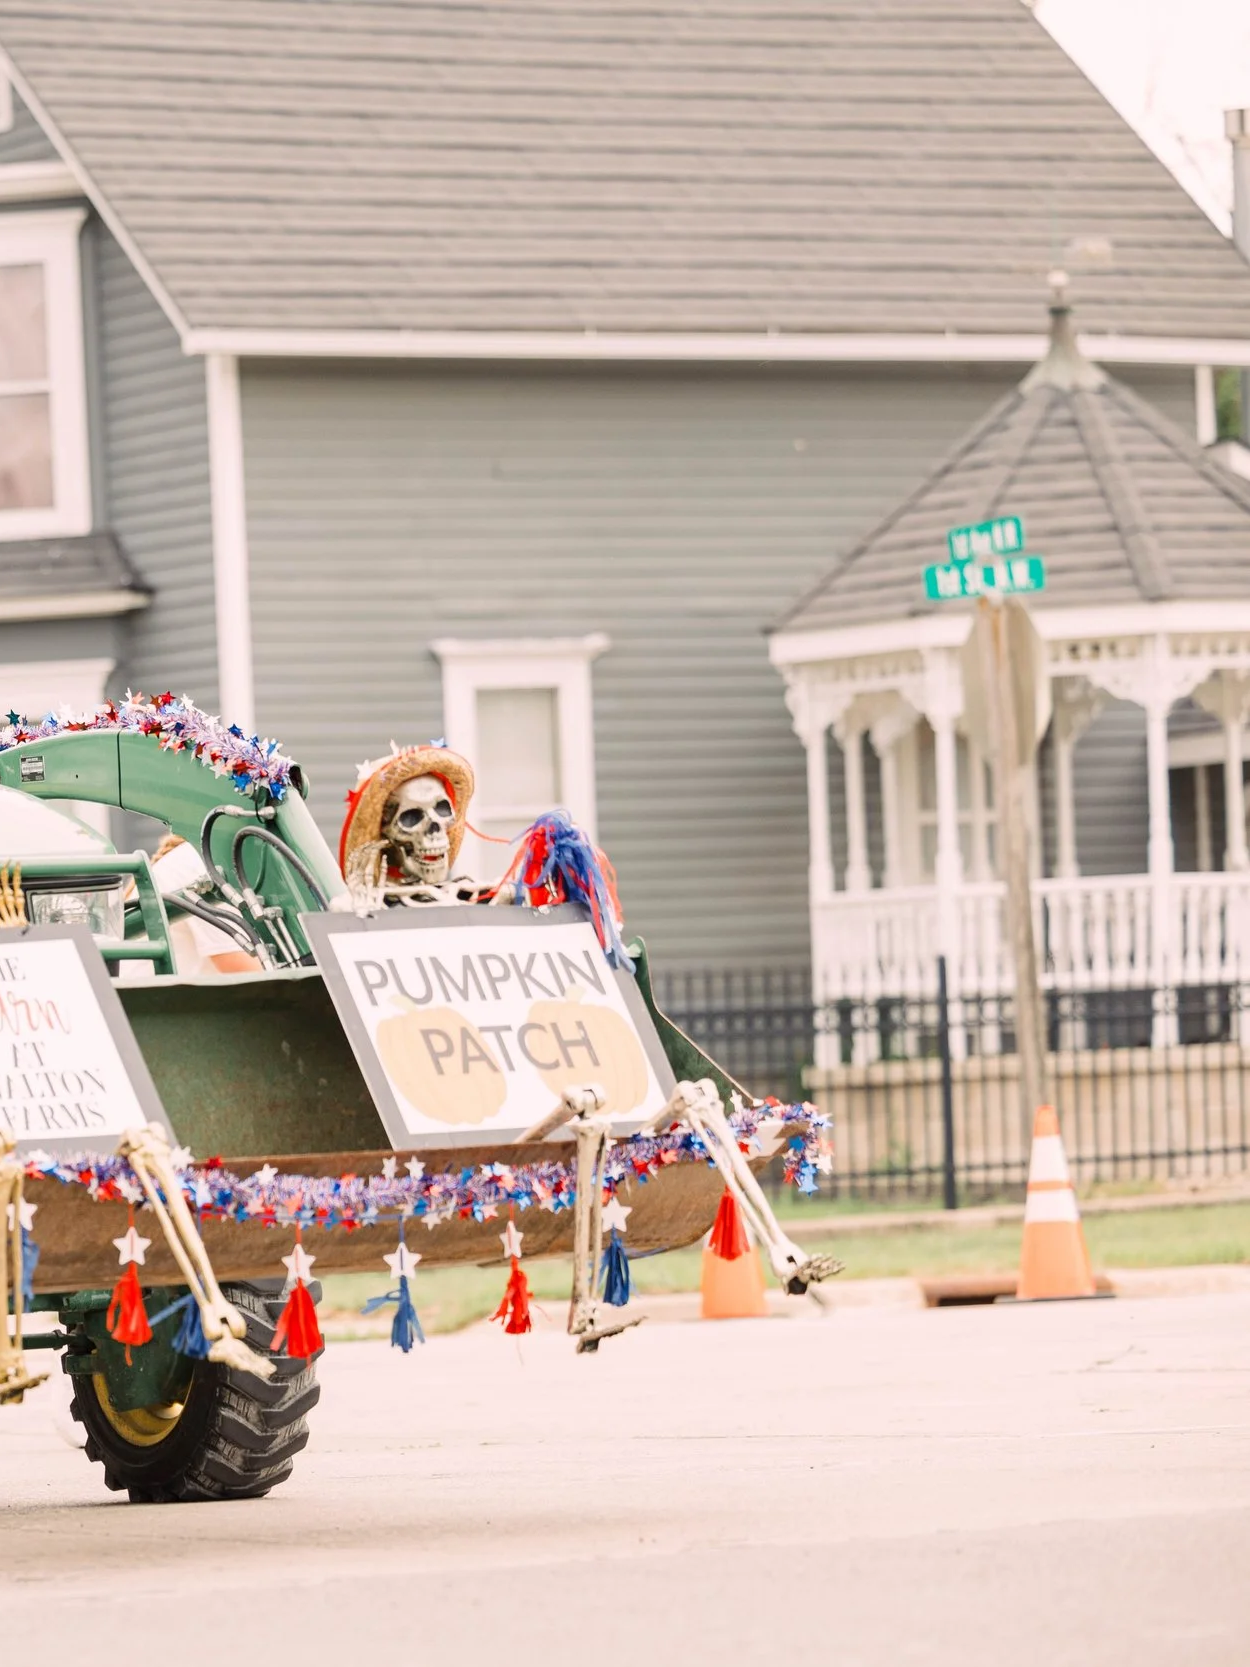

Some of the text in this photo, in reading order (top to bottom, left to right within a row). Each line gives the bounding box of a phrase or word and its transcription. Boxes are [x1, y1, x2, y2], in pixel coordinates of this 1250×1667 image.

[354, 950, 606, 1006] PUMPKIN
[419, 1021, 600, 1075] PATCH
[2, 1102, 107, 1131] FARMS
